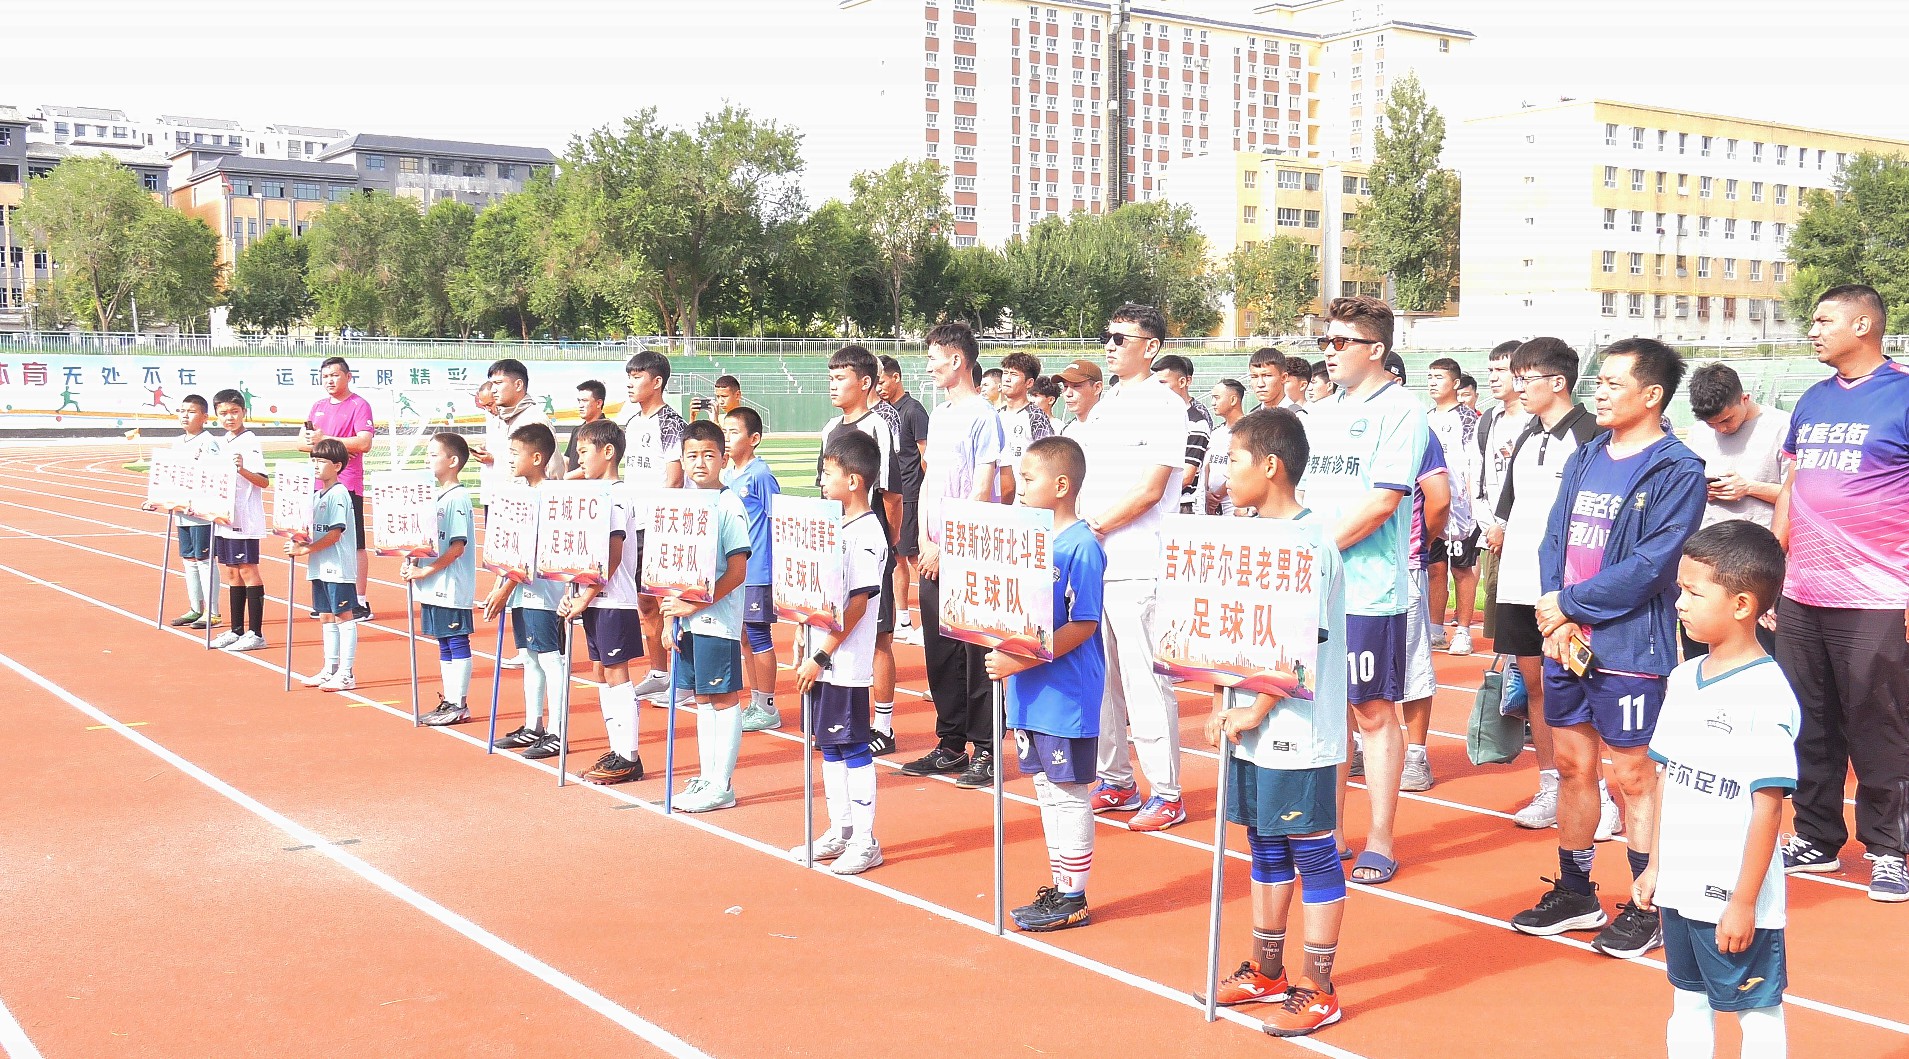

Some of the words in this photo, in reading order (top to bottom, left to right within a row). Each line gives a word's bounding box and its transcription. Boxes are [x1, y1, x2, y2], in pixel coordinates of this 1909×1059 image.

[1308, 454, 1360, 476] 努斯诊所
[653, 506, 709, 537] 新天物资
[550, 529, 588, 555] 足球队
[657, 543, 698, 572] 足球队
[944, 520, 1047, 570] 居努斯诊所北斗星
[784, 556, 822, 594] 足球队
[1165, 539, 1314, 594] 吉木萨尔县老男孩
[963, 570, 1024, 616] 足球队
[1188, 597, 1277, 649] 足球队
[1347, 650, 1375, 685] 10
[1618, 693, 1645, 732] 11
